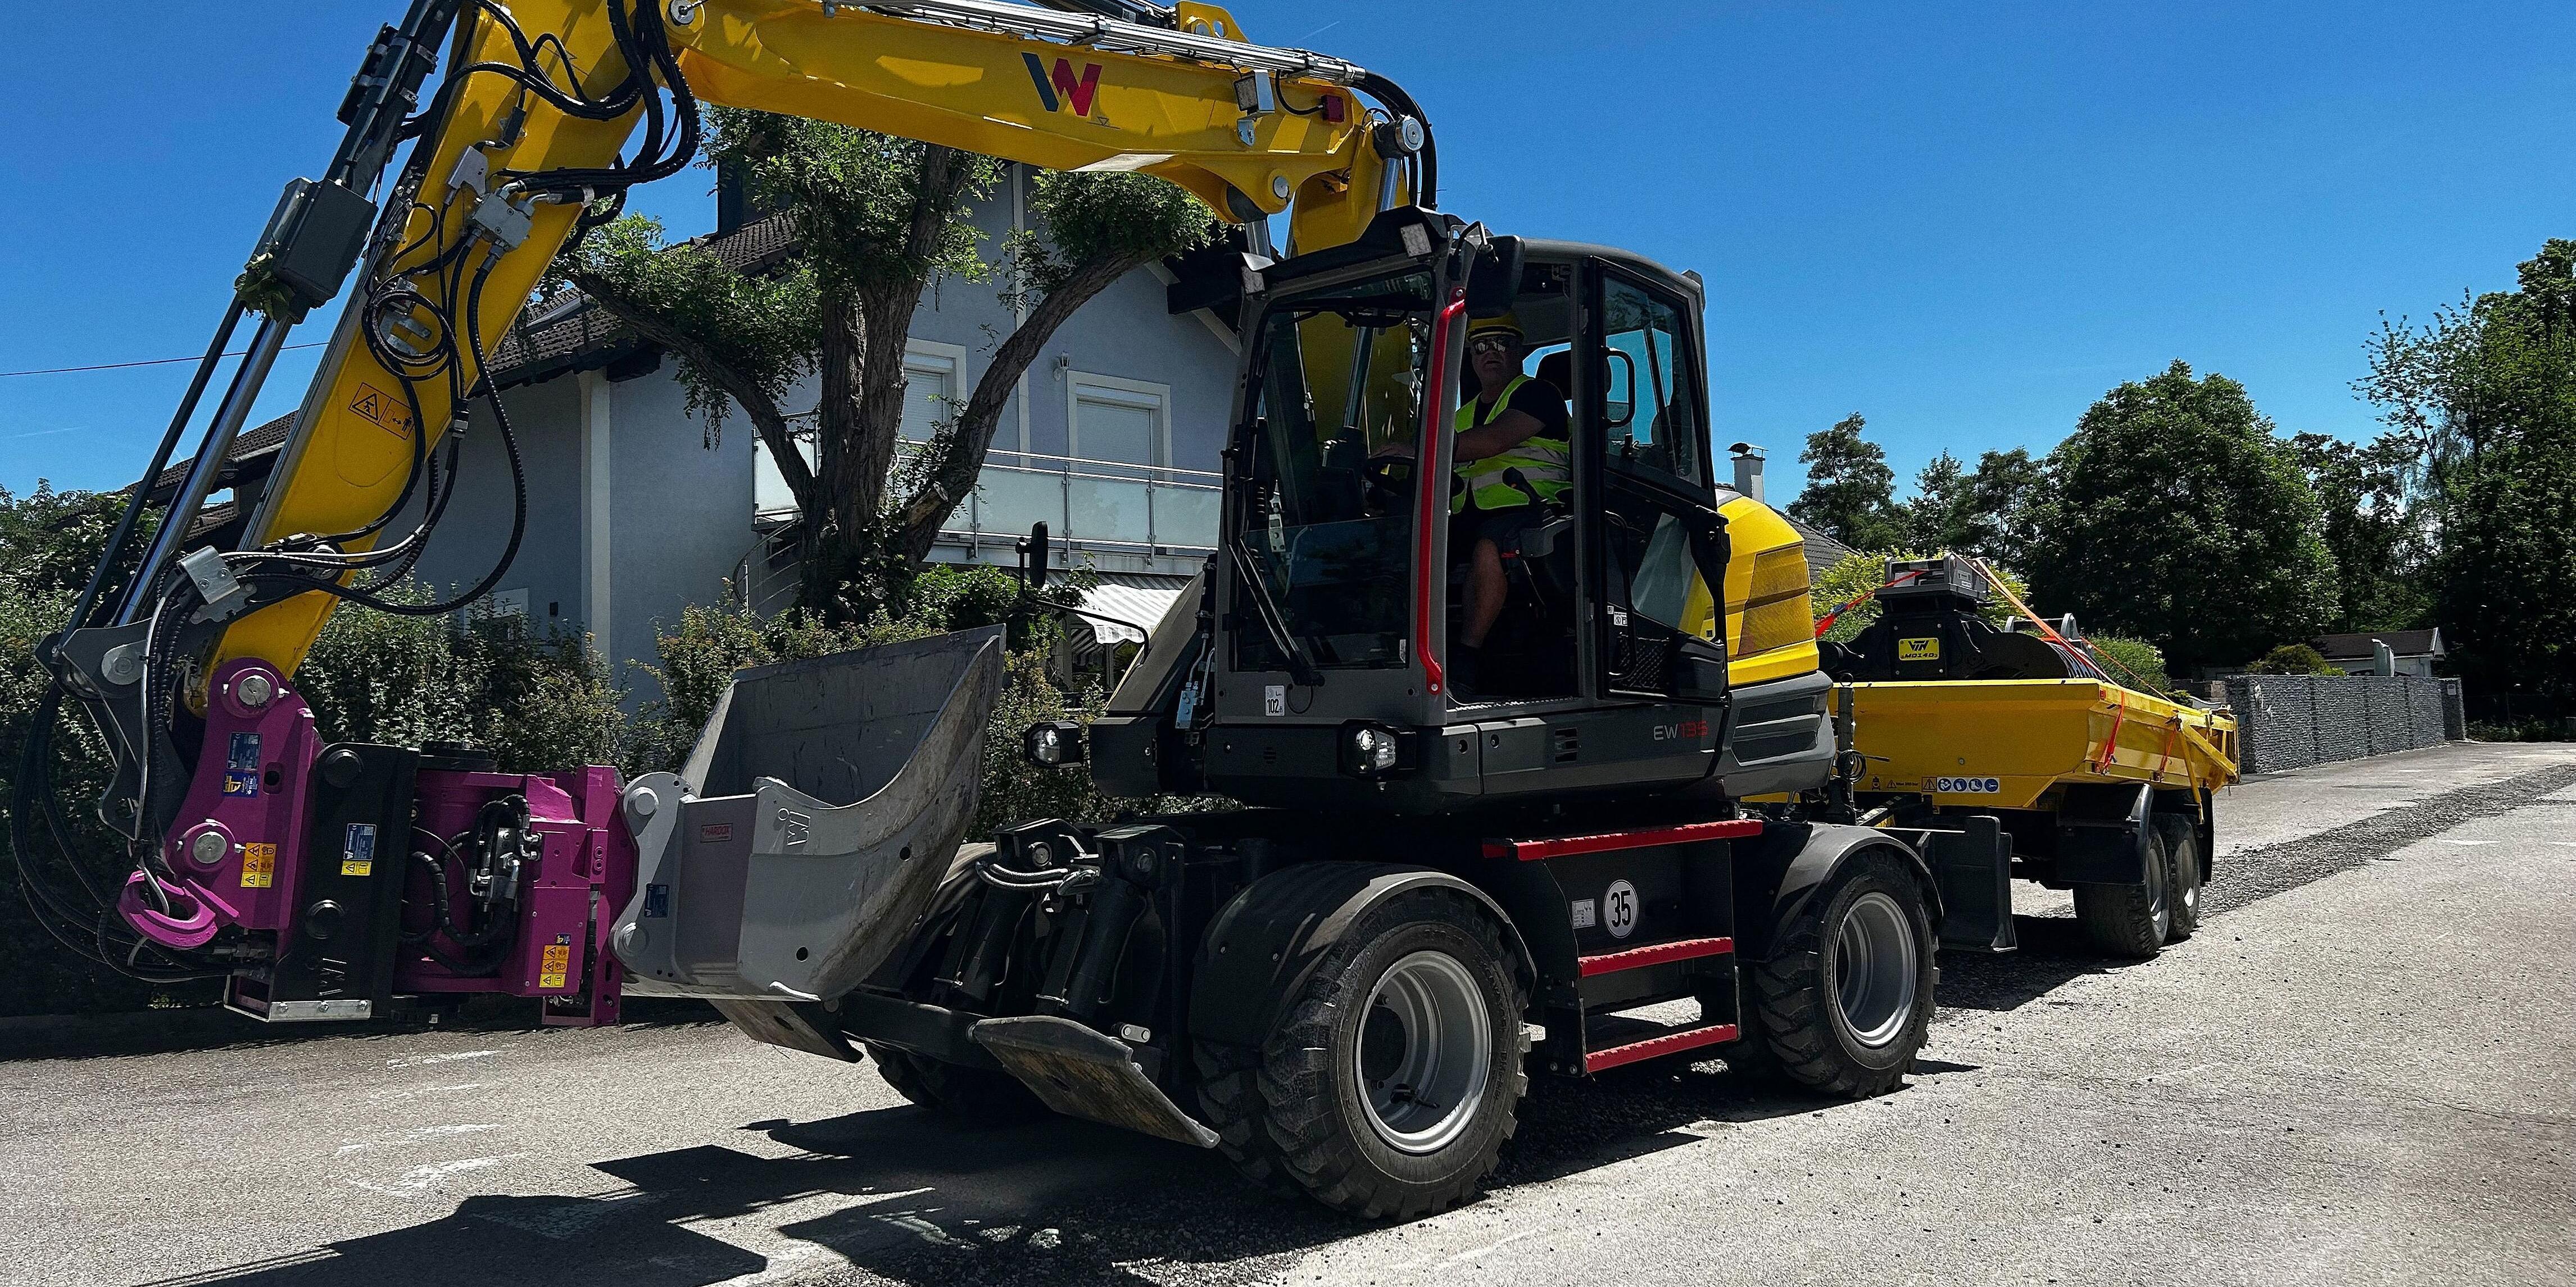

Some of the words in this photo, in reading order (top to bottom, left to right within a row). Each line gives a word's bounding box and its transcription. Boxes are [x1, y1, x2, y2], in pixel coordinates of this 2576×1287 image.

[1021, 51, 1103, 117] W
[1267, 699, 1280, 714] 102
[1653, 720, 1709, 741] EW135
[1611, 890, 1631, 928] 35
